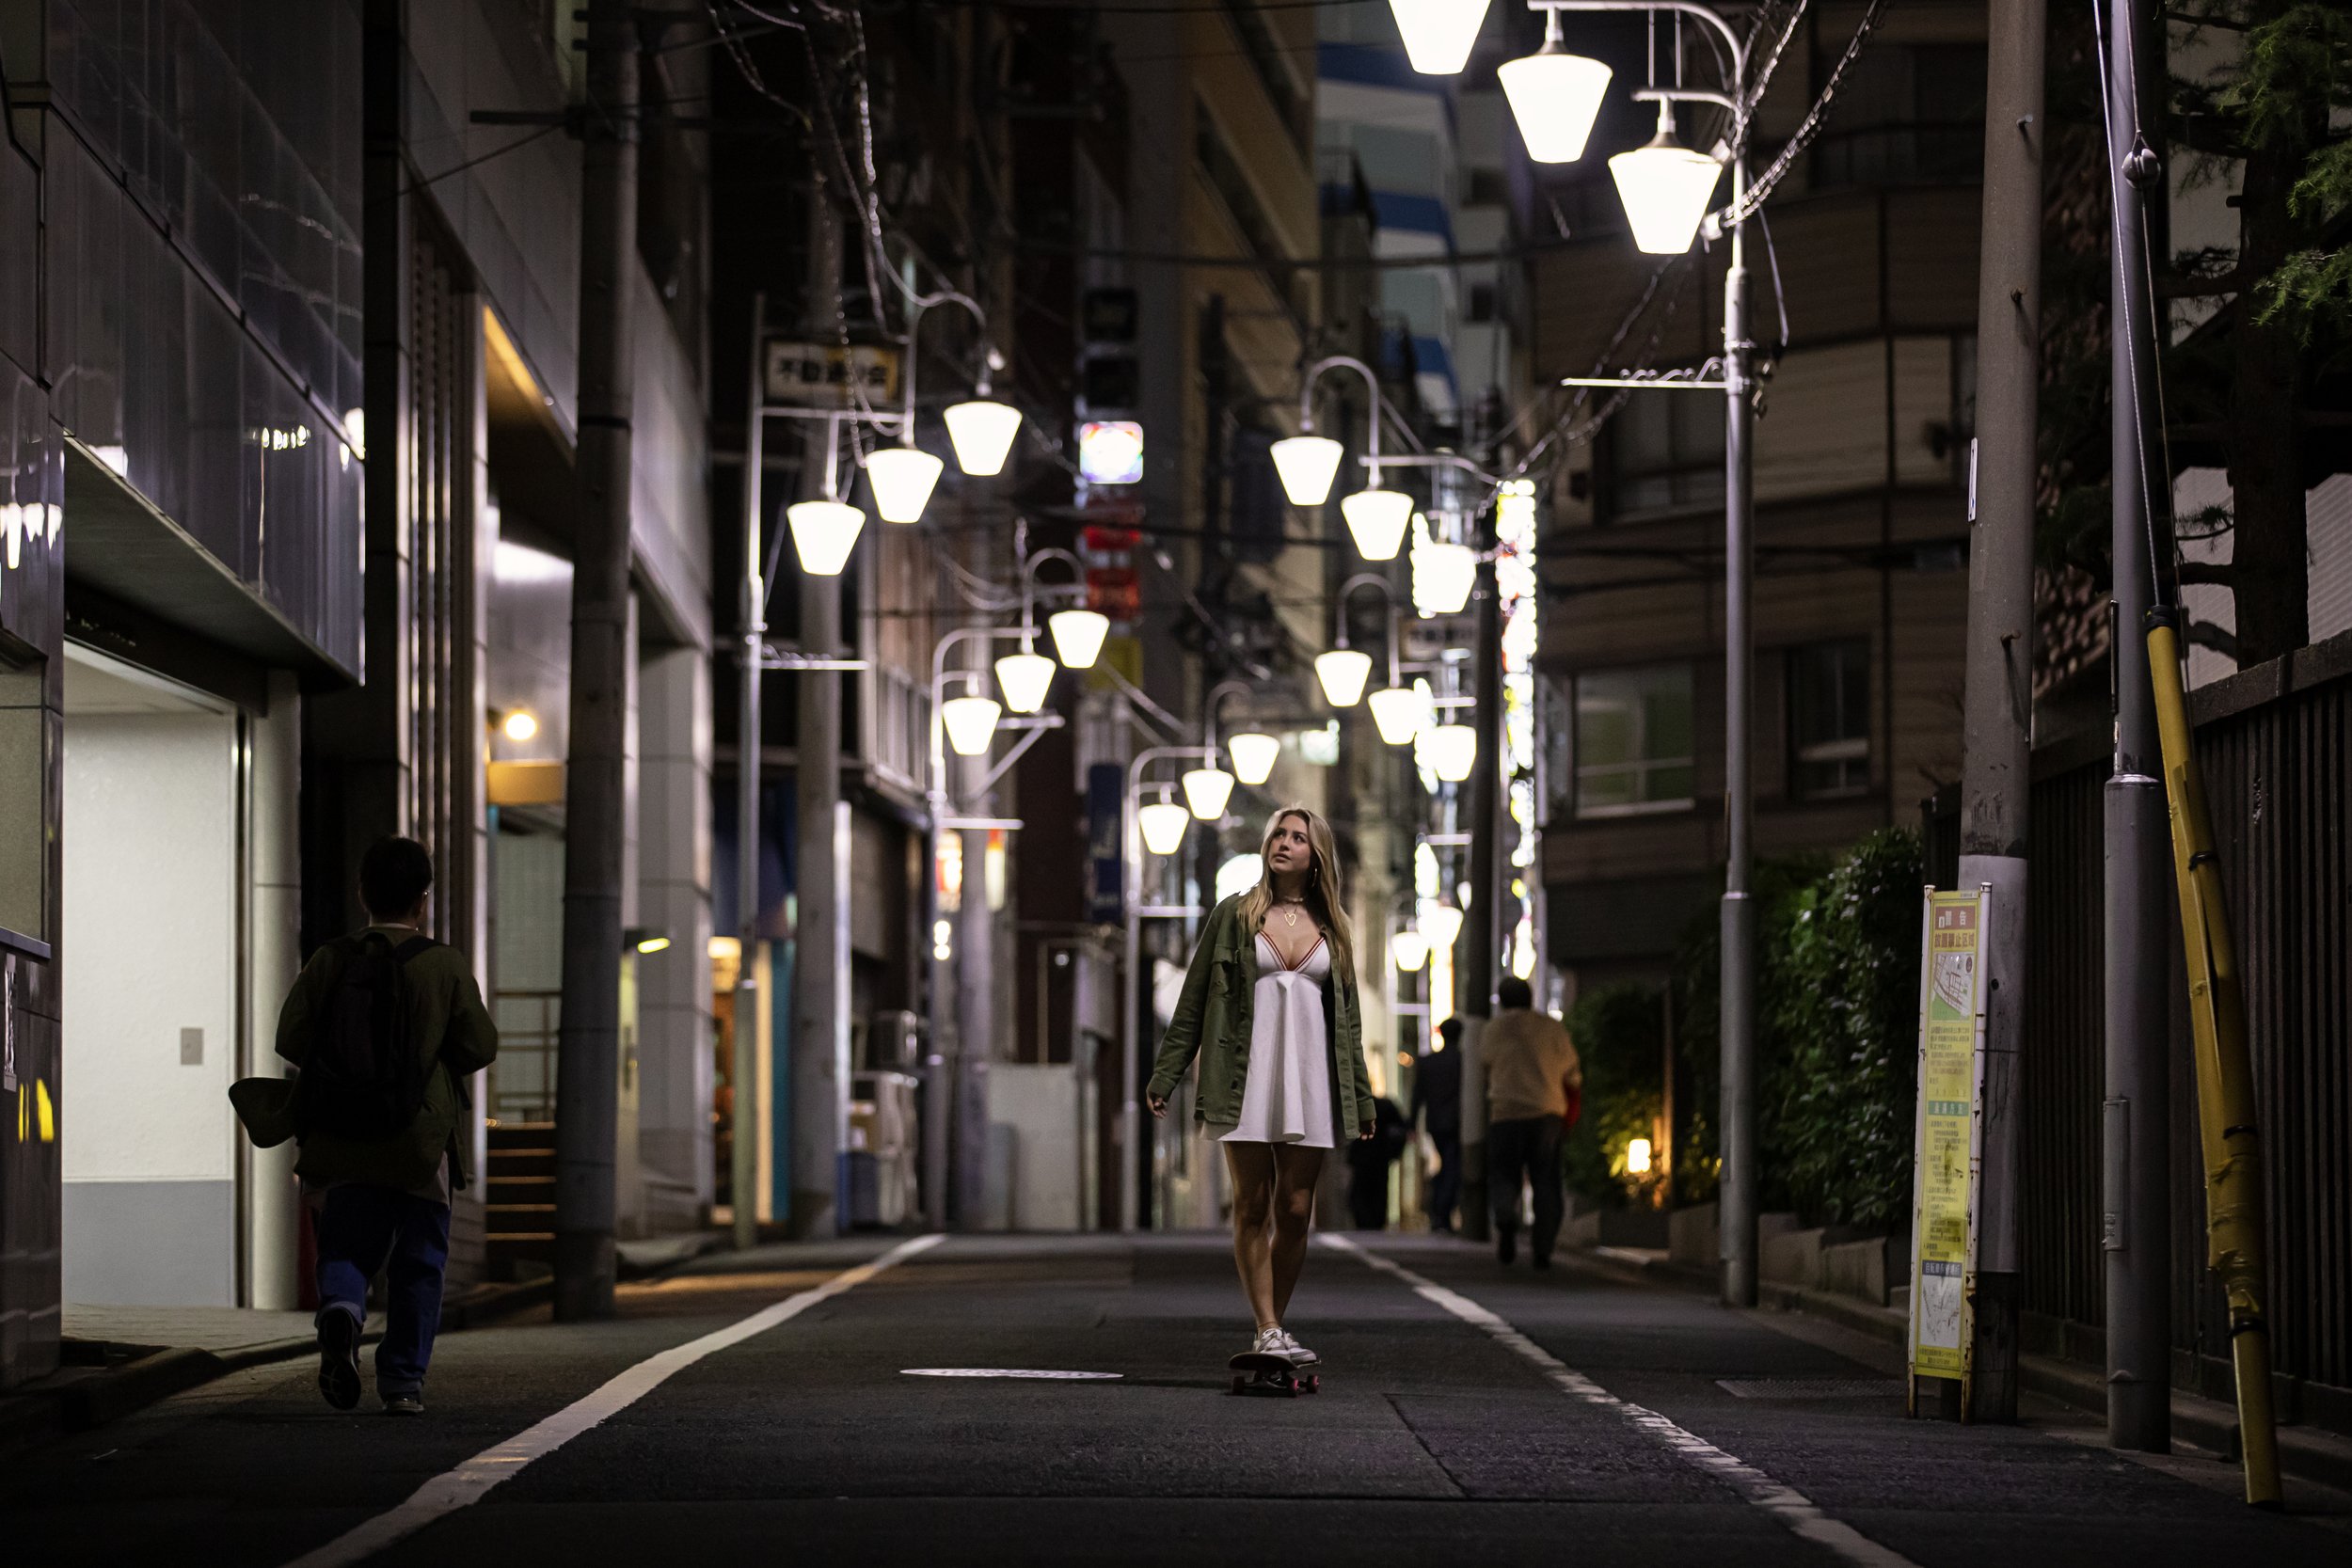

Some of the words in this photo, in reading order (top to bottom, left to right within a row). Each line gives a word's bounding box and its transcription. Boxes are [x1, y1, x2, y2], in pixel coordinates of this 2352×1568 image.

[1933, 932, 1975, 948] 放置禁止区域
